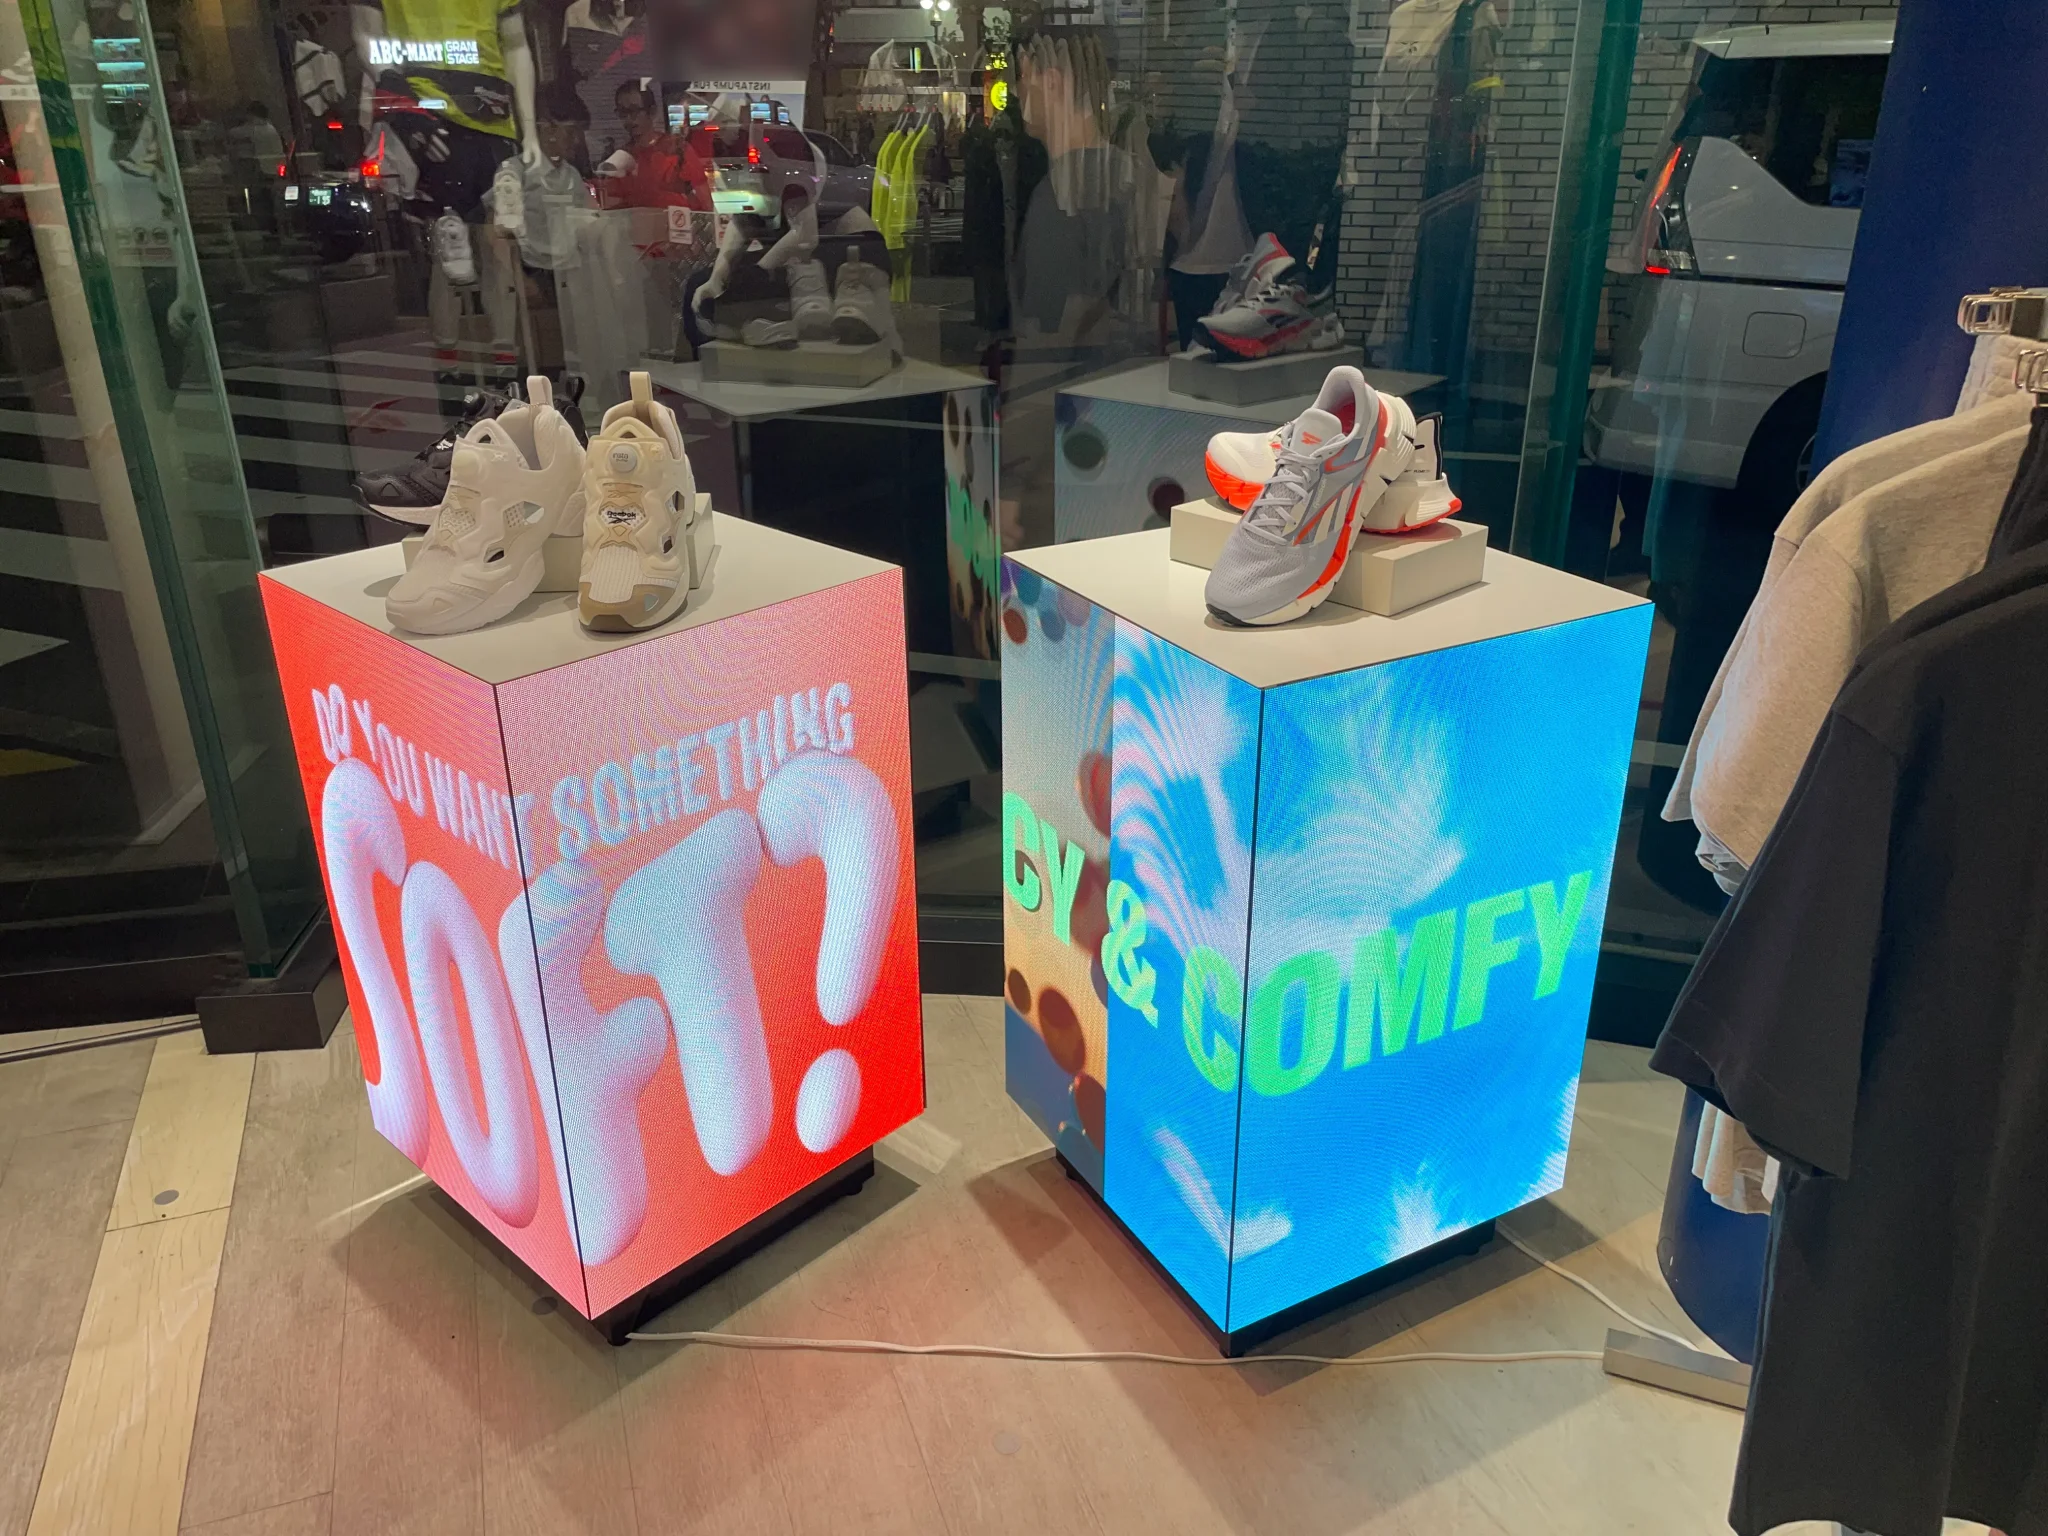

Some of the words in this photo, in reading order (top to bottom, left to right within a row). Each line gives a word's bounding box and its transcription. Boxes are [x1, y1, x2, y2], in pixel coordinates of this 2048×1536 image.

[369, 40, 443, 64] ABC-MART
[446, 53, 479, 64] STAGE
[312, 683, 352, 764] DO
[353, 699, 425, 818] YOU
[426, 750, 536, 879] WANT
[551, 682, 855, 861] SOMETHING
[322, 747, 901, 1266] SOFT?
[1101, 879, 1158, 1028] &
[1184, 871, 1591, 1097] COMFY
